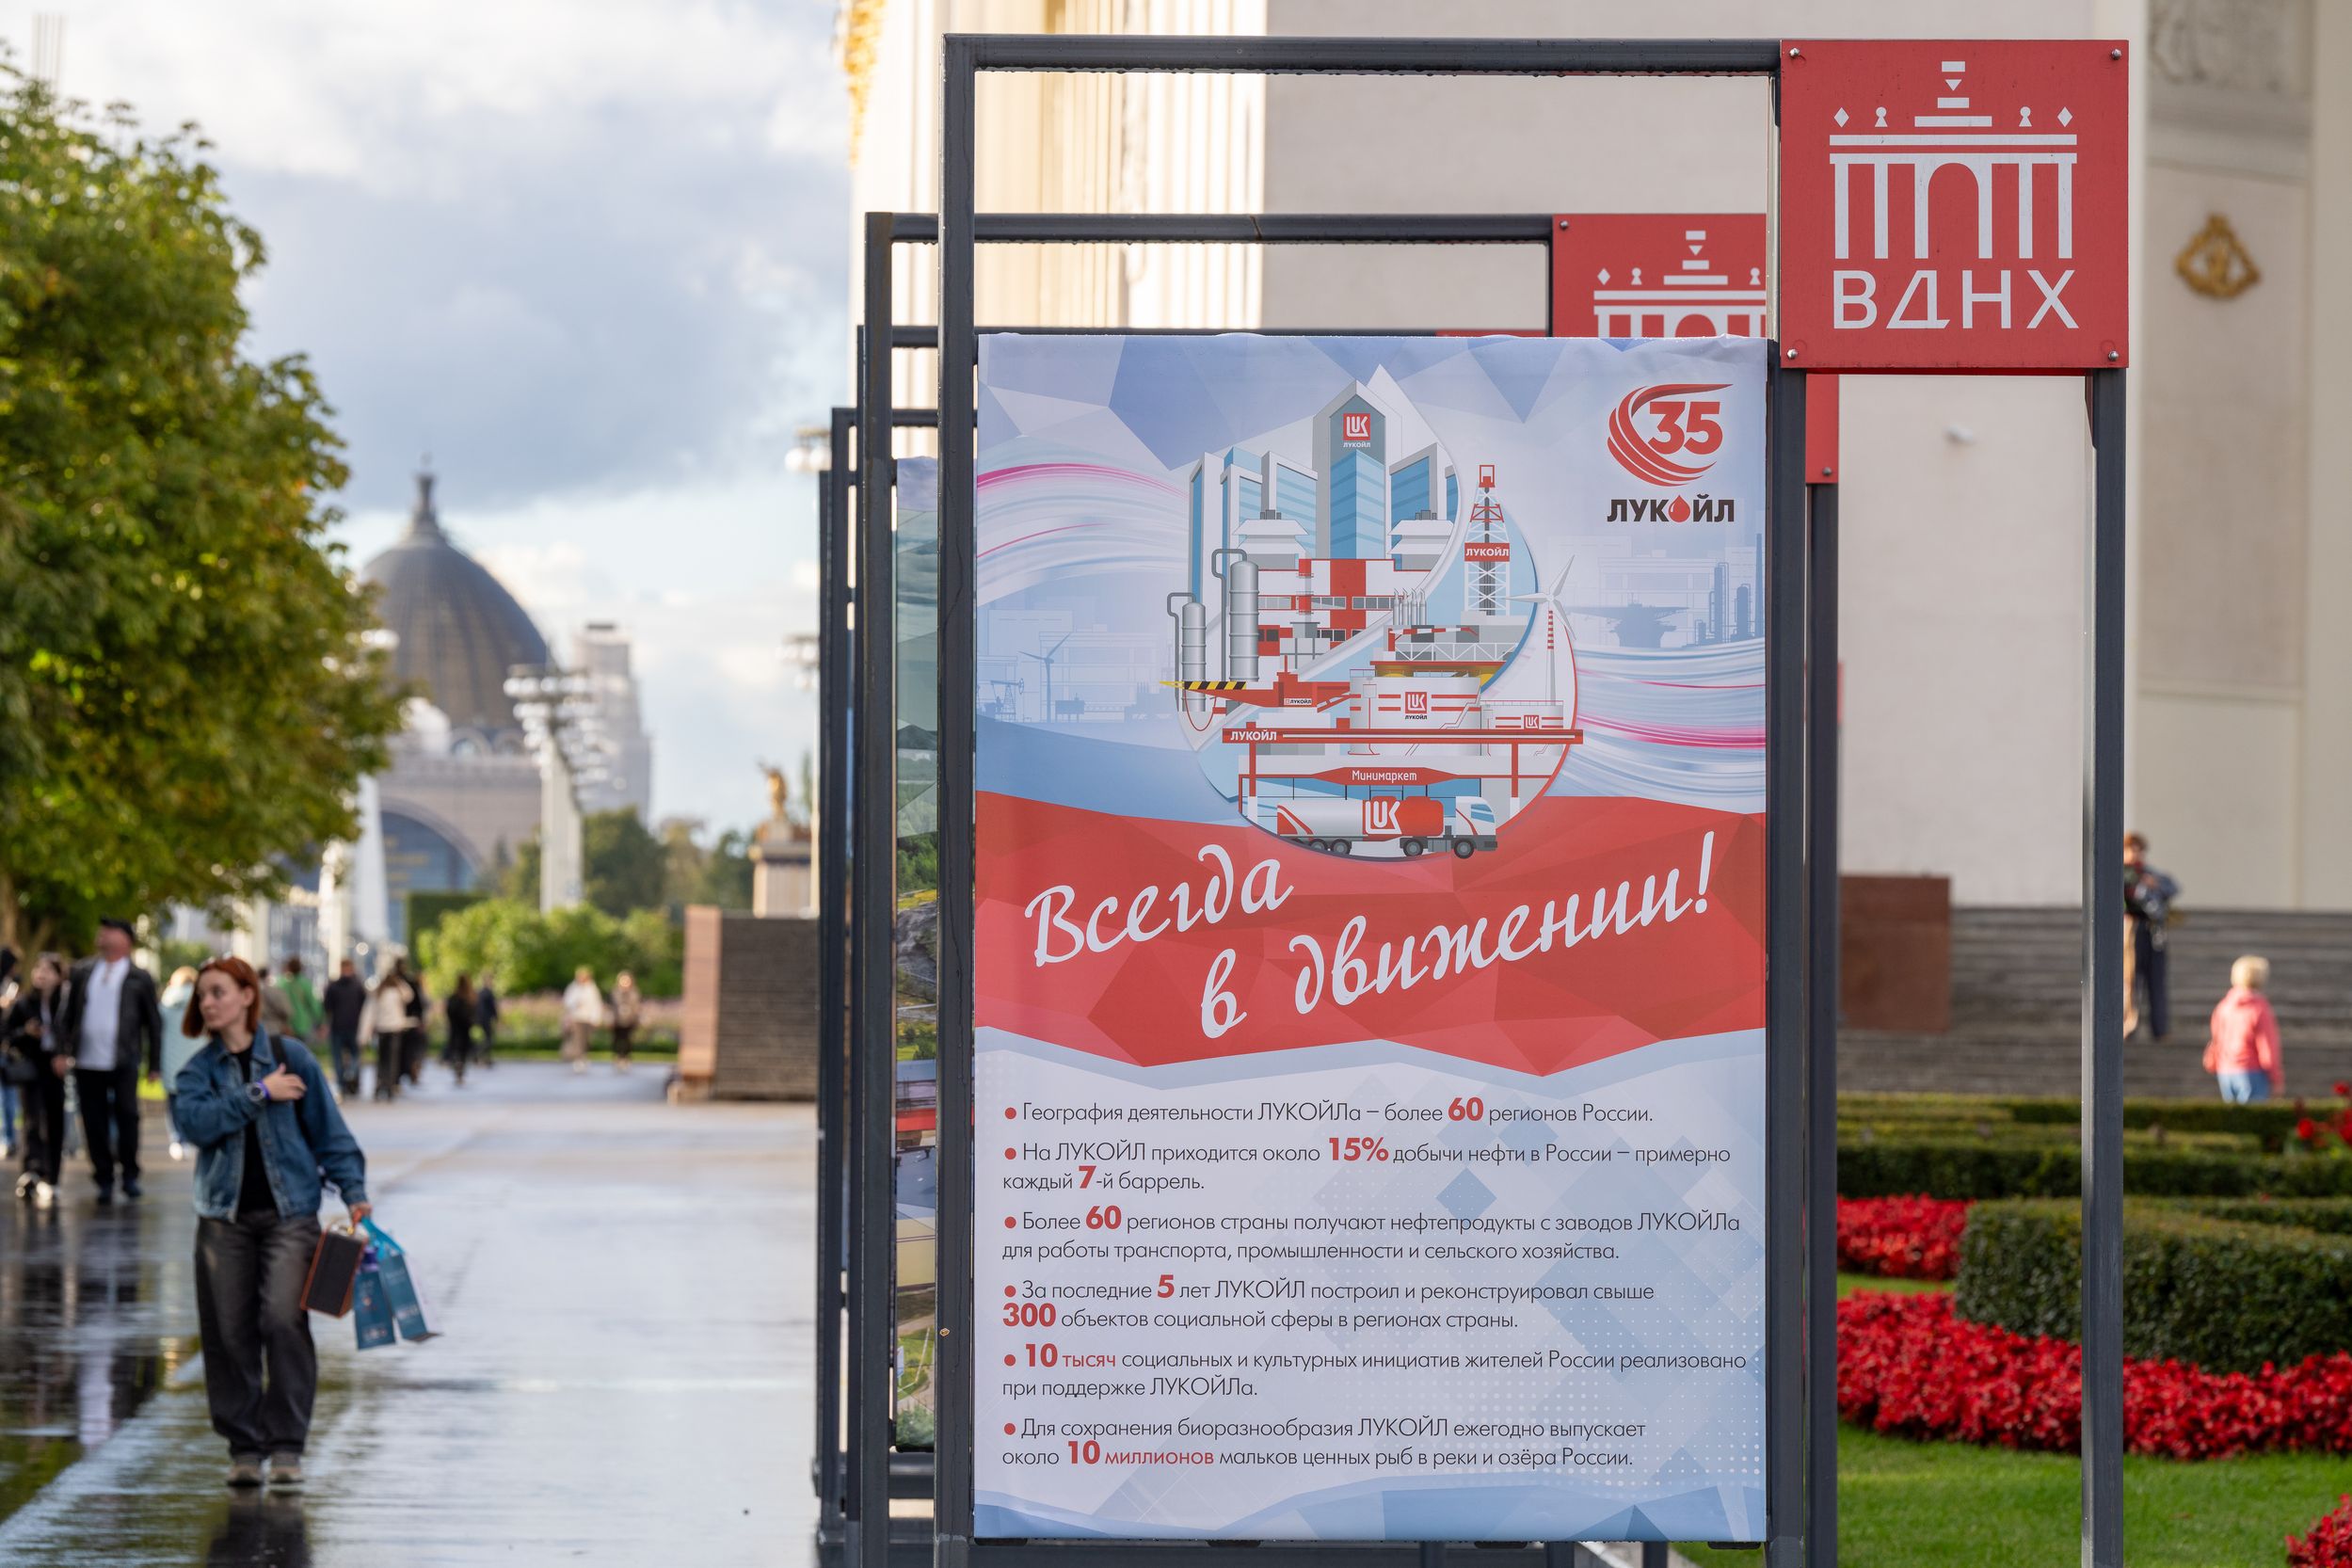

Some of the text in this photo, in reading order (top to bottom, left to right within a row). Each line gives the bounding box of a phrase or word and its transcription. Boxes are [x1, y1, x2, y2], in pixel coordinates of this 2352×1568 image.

[1833, 269, 2079, 329] ВДНХ
[1648, 401, 1723, 455] 35
[1465, 547, 1509, 556] ЛУКОЙЛ
[1230, 729, 1277, 741] ЛУКОЙЛ
[1352, 770, 1417, 783] Минимаркет
[1025, 844, 1295, 967] Всегда
[1201, 831, 1715, 1038] в движении!
[1023, 1101, 1123, 1126] География
[1127, 1108, 1254, 1123] деятельности
[1256, 1098, 1361, 1122] ЛУКОЙЛа
[1384, 1101, 1444, 1122] более
[1448, 1096, 1484, 1122] 60
[1489, 1109, 1577, 1127] регионов
[1582, 1103, 1654, 1122] России.
[1023, 1142, 1051, 1161] На
[1054, 1139, 1145, 1161] ЛУКОЙЛ
[1151, 1147, 1257, 1166] приходится
[1262, 1148, 1320, 1161] около
[1328, 1136, 1390, 1162] 15%
[1392, 1142, 1463, 1164] добычи
[1468, 1143, 1526, 1167] нефти
[1530, 1149, 1541, 1162] в
[1545, 1143, 1612, 1162] России
[1635, 1149, 1731, 1167] примерно
[1002, 1164, 1205, 1194] каждый 7-й баррель.
[1023, 1205, 1740, 1236] Более 60 регионов страны получают нефтепродукты с заводов ЛУКОЙЛа
[1001, 1239, 1620, 1263] для работы транспорта, промышленности и сельского хозяйства.
[1021, 1273, 1655, 1304] За последние 5 лет ЛУКОЙЛ построил и реконструировал свыше
[1002, 1302, 1518, 1333] 300 объектов социальной сферы в регионах страны.
[1025, 1342, 1747, 1373] 10 тысяч социальных и культурных инициатив жителей России реализовано
[1002, 1373, 1258, 1401] при поддержке ЛУКОЙЛа.
[1020, 1415, 1647, 1442] Для сохранения биоразнообразия ЛУКОЙЛ ежегодно выпускает
[1001, 1440, 1633, 1470] около 10 миллионов мальков ценных рыб в реки и озёра России.
